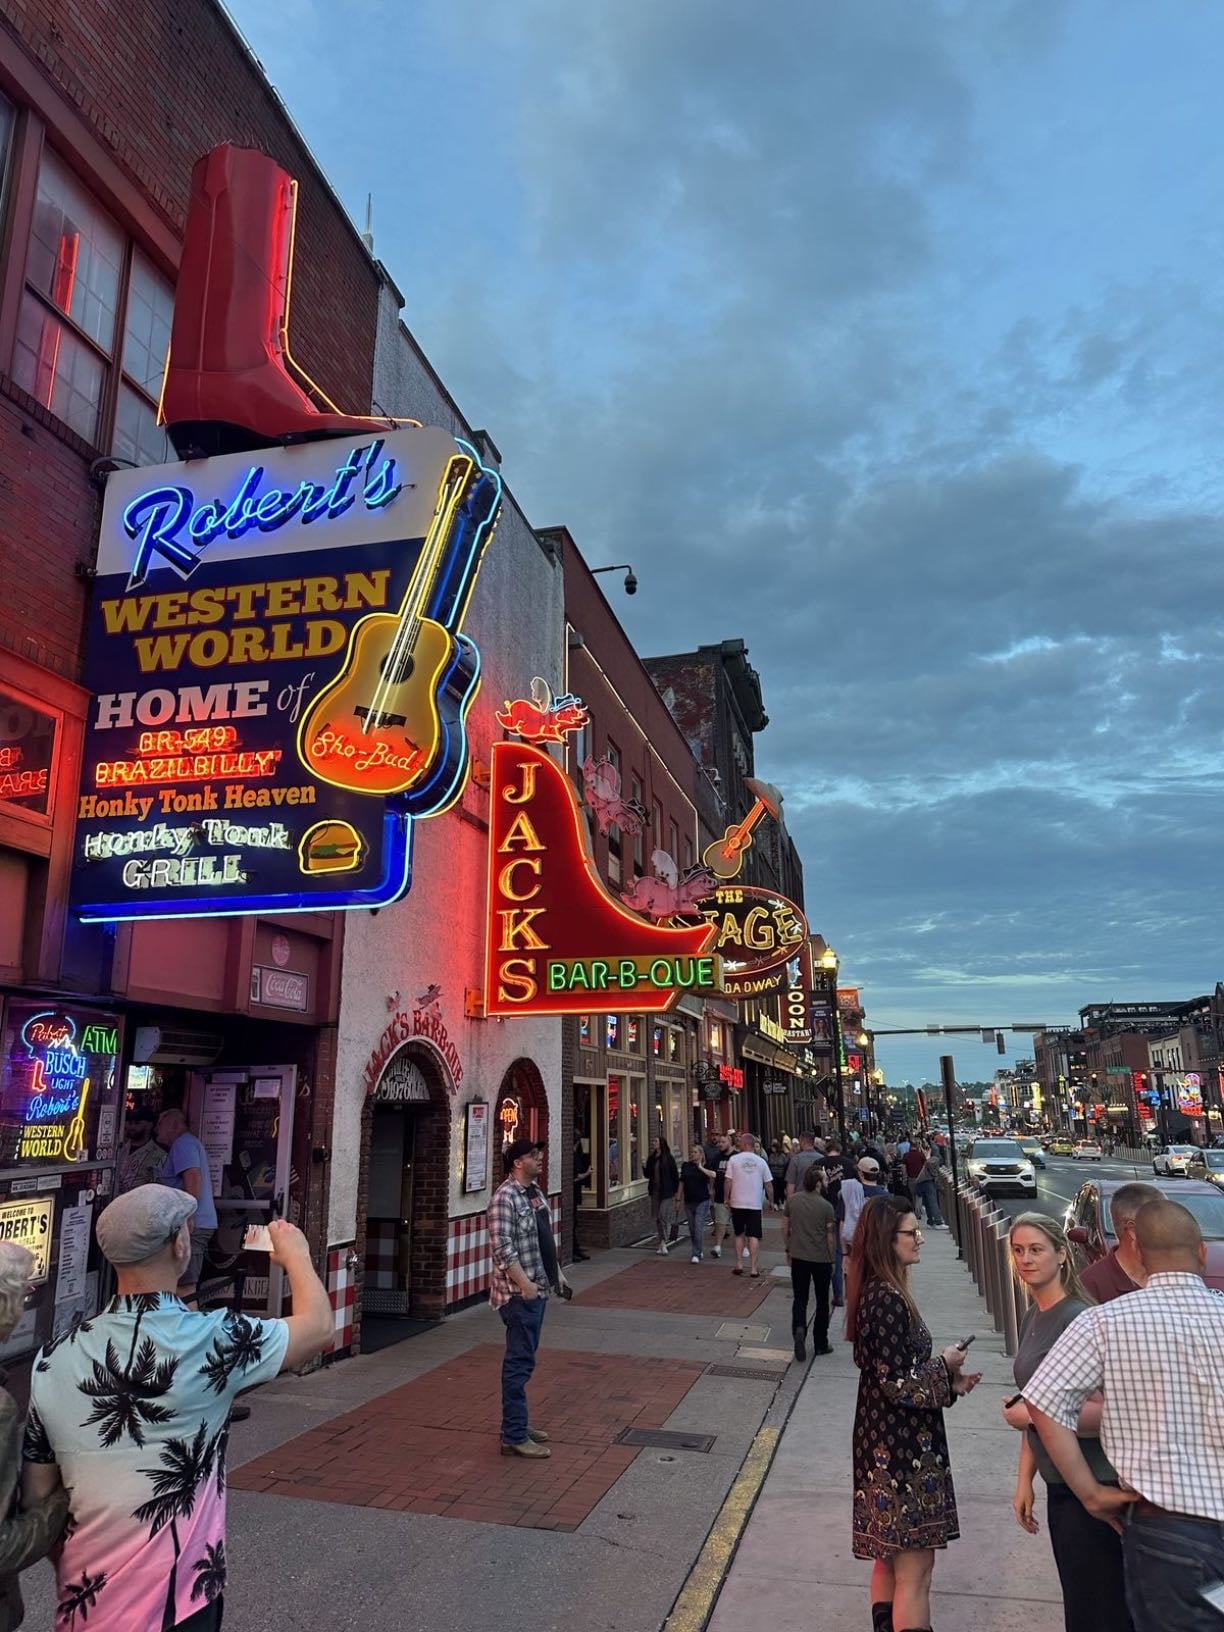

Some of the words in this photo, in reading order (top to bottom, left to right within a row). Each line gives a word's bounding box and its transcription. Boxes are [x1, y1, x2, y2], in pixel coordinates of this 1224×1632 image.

[124, 439, 400, 592] Robert's
[101, 569, 391, 635] WESTERN
[134, 619, 348, 673] WORLD
[94, 680, 270, 730] HOME
[277, 672, 315, 723] of
[139, 725, 238, 757] BR-549
[311, 731, 418, 772] Sho-Bud
[95, 750, 282, 788] BRAZILBILLY
[78, 793, 153, 822] Honky
[159, 787, 218, 814] Tonk
[224, 783, 316, 808] Heaven
[84, 822, 194, 861] Honky
[202, 819, 293, 850] Tonk
[122, 853, 250, 889] GRILL
[497, 761, 550, 1004] JACKS
[715, 889, 744, 904] THE
[549, 957, 714, 990] BAR-B-QUE
[31, 1023, 69, 1042] Pabst
[80, 1024, 118, 1055] ATM
[44, 1051, 87, 1078] BUSCH
[51, 1078, 75, 1090] LIGHT
[26, 1090, 79, 1121] Robert's
[20, 1138, 62, 1157] WORLD
[23, 1125, 65, 1139] WESTERN
[2, 1208, 28, 1219] WELCOME
[28, 1206, 34, 1215] TO
